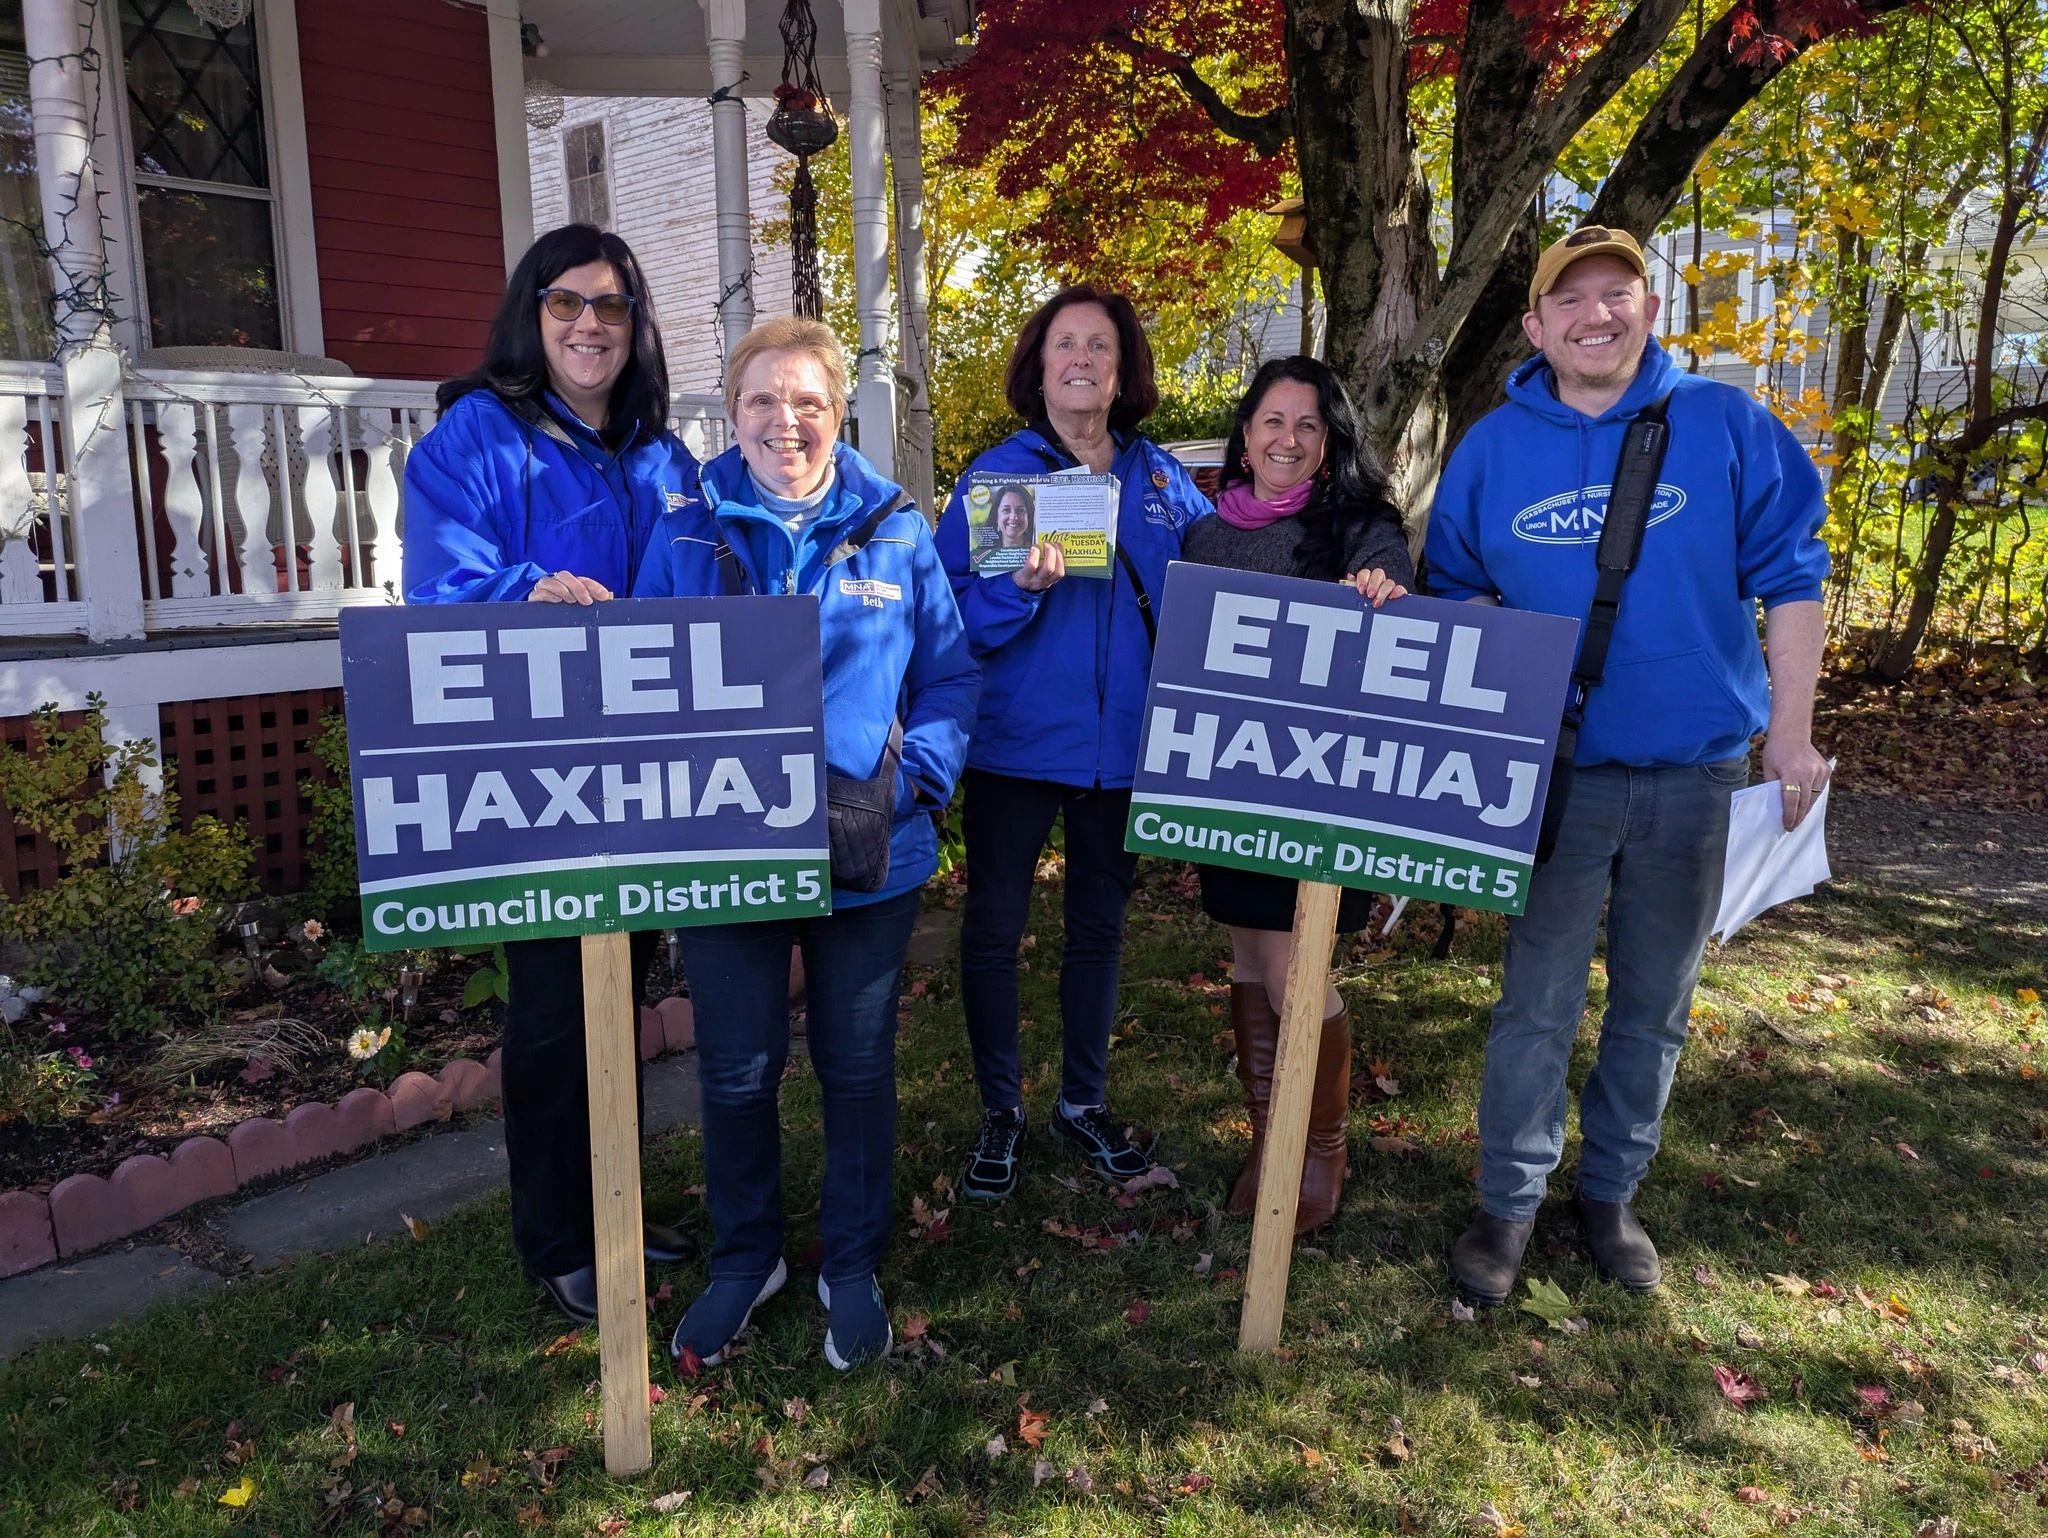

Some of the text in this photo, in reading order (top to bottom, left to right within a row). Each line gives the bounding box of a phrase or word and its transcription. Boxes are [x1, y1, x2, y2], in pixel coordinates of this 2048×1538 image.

[1526, 521, 1547, 530] UNION
[1550, 504, 1608, 533] MN
[844, 582, 873, 591] MNA
[862, 595, 884, 608] Beth
[406, 622, 764, 724] ETEL
[1203, 591, 1507, 713] ETEL
[362, 753, 816, 855] HAXHIAJ
[1143, 706, 1540, 828] HAXHIAJ
[1133, 812, 1519, 897] Councilor District 5
[372, 869, 821, 935] Councilor District 5
